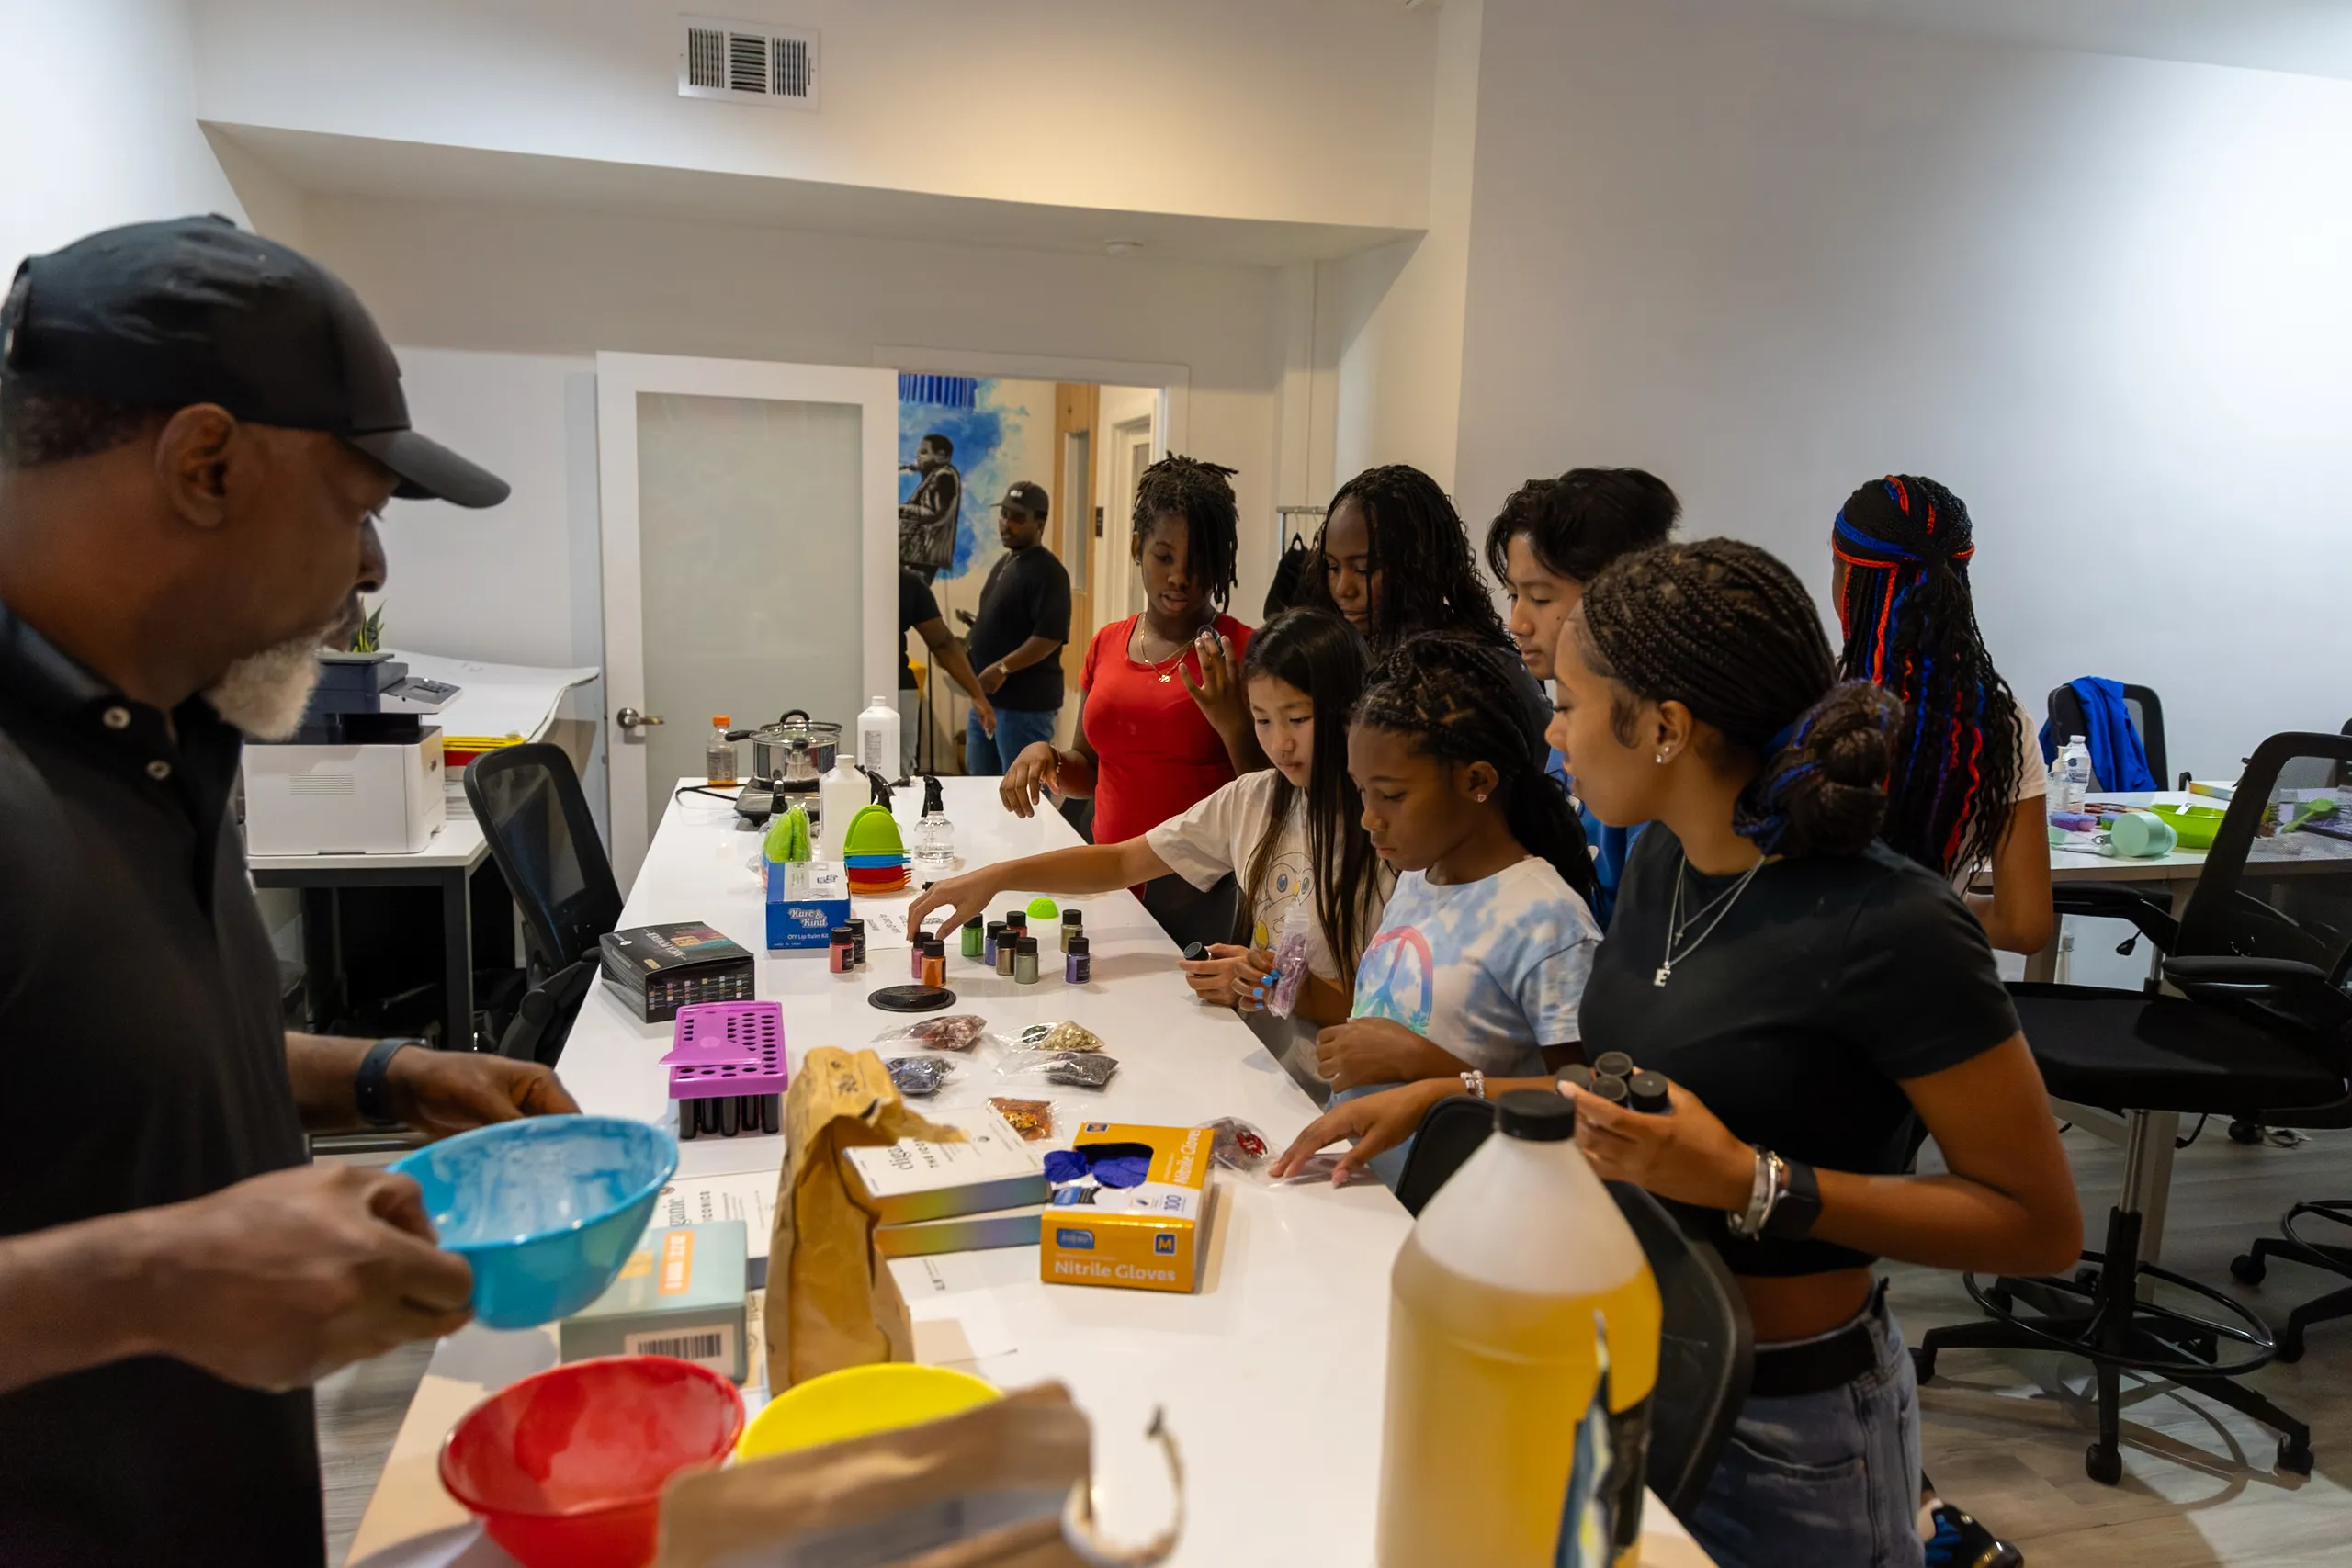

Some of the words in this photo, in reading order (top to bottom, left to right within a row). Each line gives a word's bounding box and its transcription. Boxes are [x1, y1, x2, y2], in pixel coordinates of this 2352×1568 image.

[801, 918, 827, 928] Kind
[1159, 1237, 1172, 1250] M
[1055, 1260, 1112, 1277] Nitrile
[1114, 1264, 1176, 1281] Gloves
